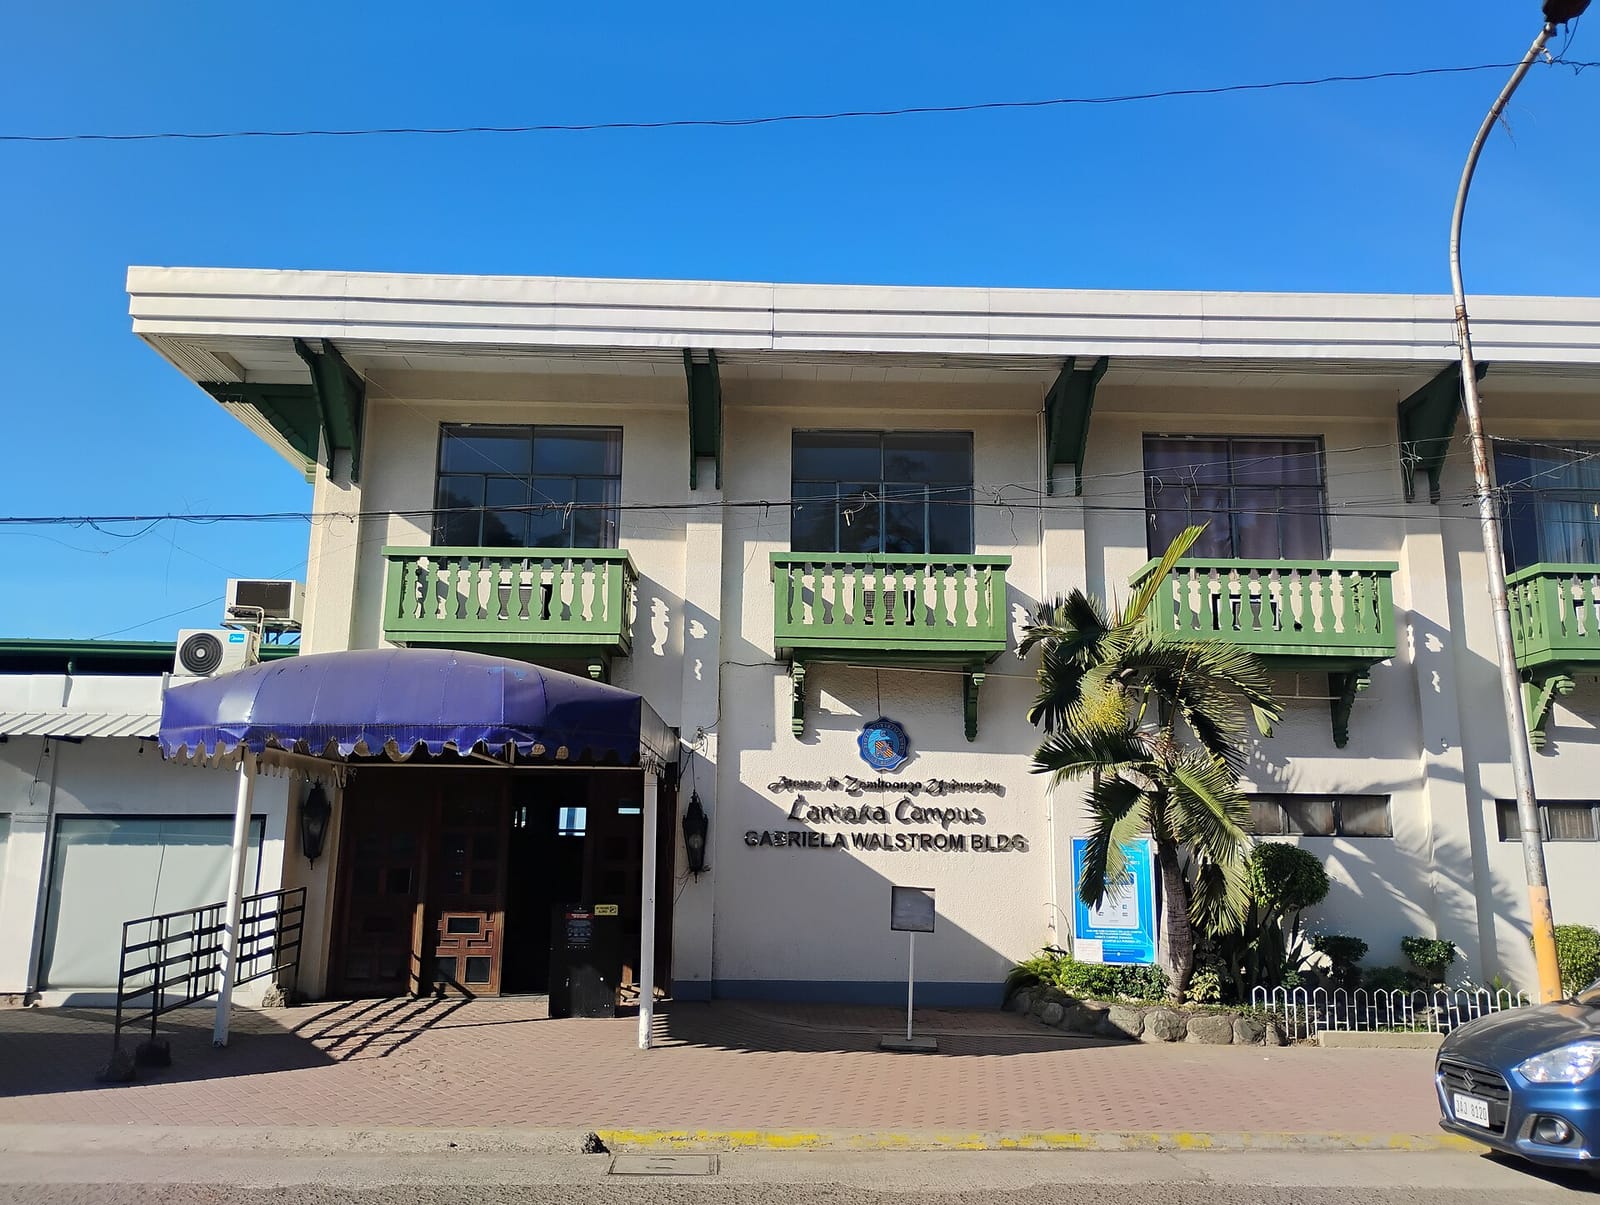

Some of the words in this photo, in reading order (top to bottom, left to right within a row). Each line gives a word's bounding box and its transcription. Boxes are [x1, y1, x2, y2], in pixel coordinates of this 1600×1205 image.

[843, 775, 921, 793] Zamboanga
[926, 778, 1001, 793] University
[787, 793, 887, 822] Lantaka
[895, 795, 983, 830] Campus
[744, 830, 847, 848] GABRIELA
[850, 832, 964, 850] WALSTROM
[971, 833, 1028, 850] BLDG
